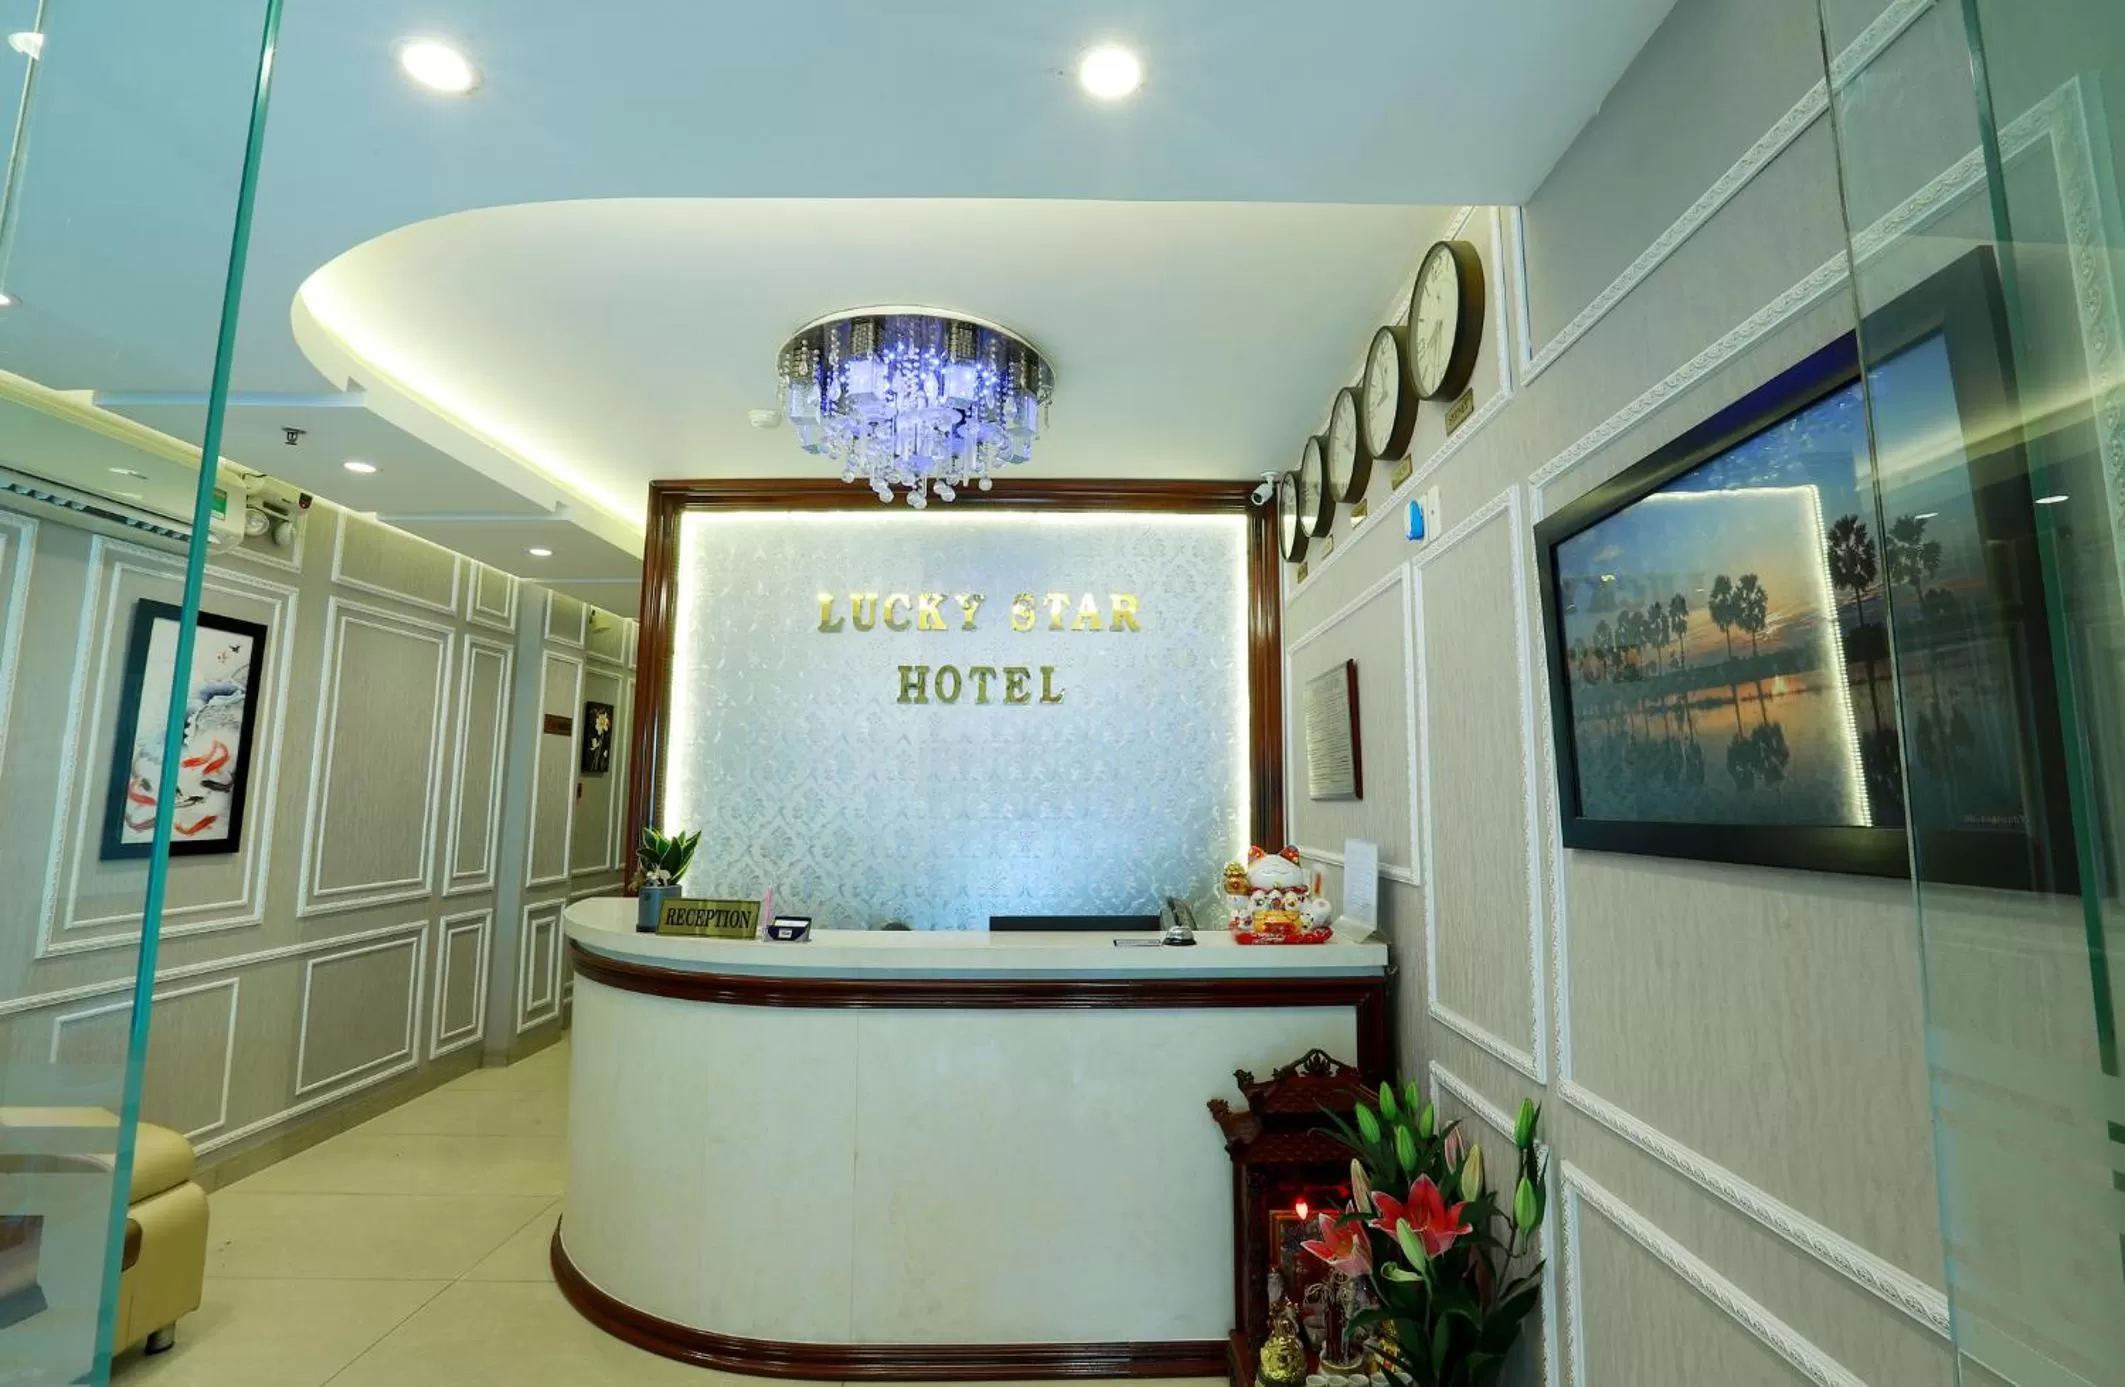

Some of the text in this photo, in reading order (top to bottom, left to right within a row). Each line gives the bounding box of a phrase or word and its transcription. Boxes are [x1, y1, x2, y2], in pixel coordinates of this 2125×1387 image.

[817, 592, 1142, 632] LUCKY STAR
[897, 665, 1065, 704] HOTEL
[666, 907, 752, 929] RECEPTION
